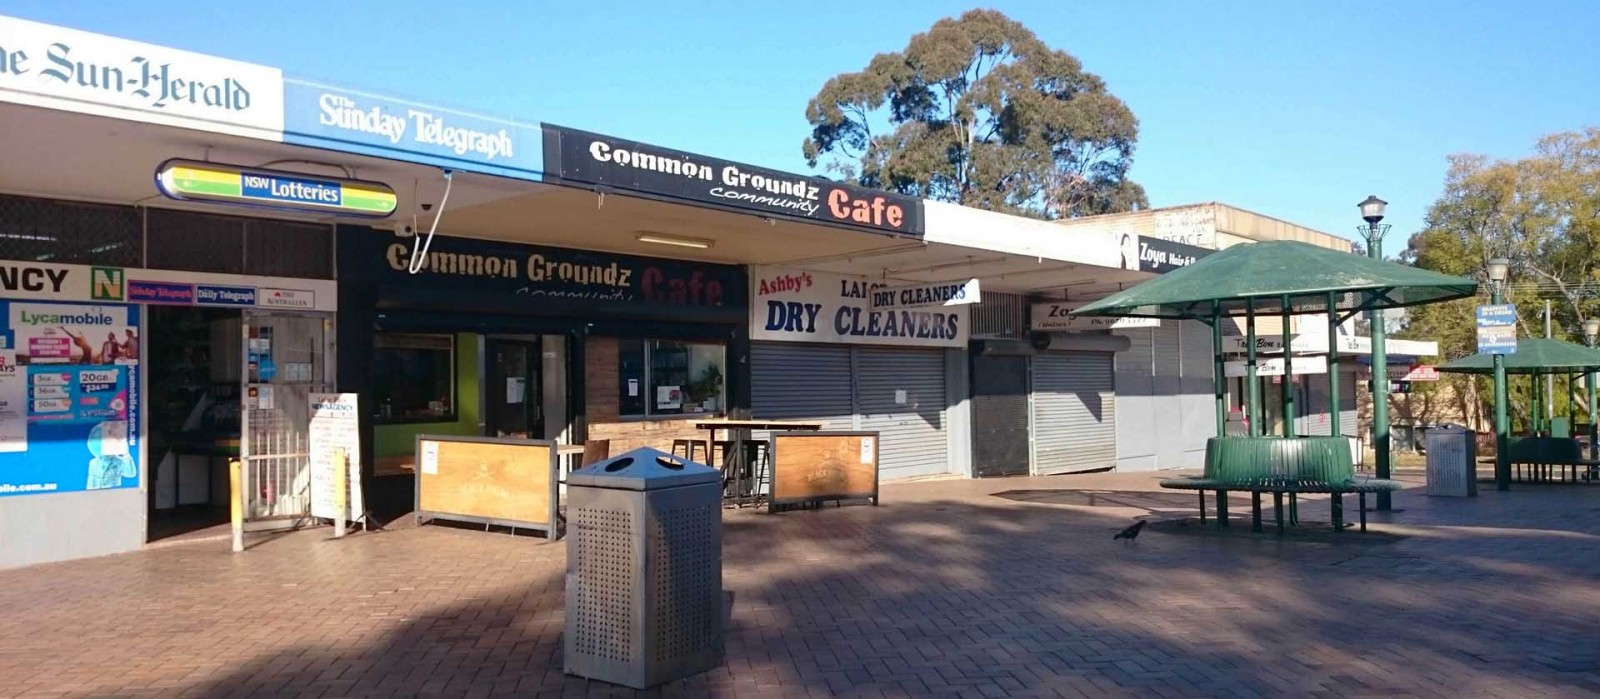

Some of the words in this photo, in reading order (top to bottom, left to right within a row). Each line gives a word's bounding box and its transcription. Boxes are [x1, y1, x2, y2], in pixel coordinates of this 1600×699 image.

[40, 42, 251, 111] Sun-Herald
[319, 93, 406, 144] Sunday
[408, 109, 513, 160] Telegraph
[588, 140, 714, 181] Common
[721, 164, 820, 201] Groundz
[244, 175, 270, 190] NSW
[271, 177, 339, 203] Lotteries
[827, 188, 904, 228] Cafe
[1140, 242, 1167, 268] Zoya
[1168, 253, 1184, 267] Hair
[386, 243, 518, 279] Common
[526, 253, 632, 287] Groundz
[640, 266, 723, 307] Cafe
[758, 272, 813, 296] Ashby's
[198, 288, 219, 300] Daily
[220, 290, 254, 302] Telegraph
[873, 290, 897, 308] DRY
[900, 283, 966, 303] CLEANERS
[21, 310, 113, 326] Lycamobile
[765, 300, 822, 333] DRY
[833, 305, 959, 340] CLEANERS
[1256, 338, 1274, 348] Bon
[82, 373, 109, 382] 20GB
[312, 403, 353, 411] NEWSAGENCY
